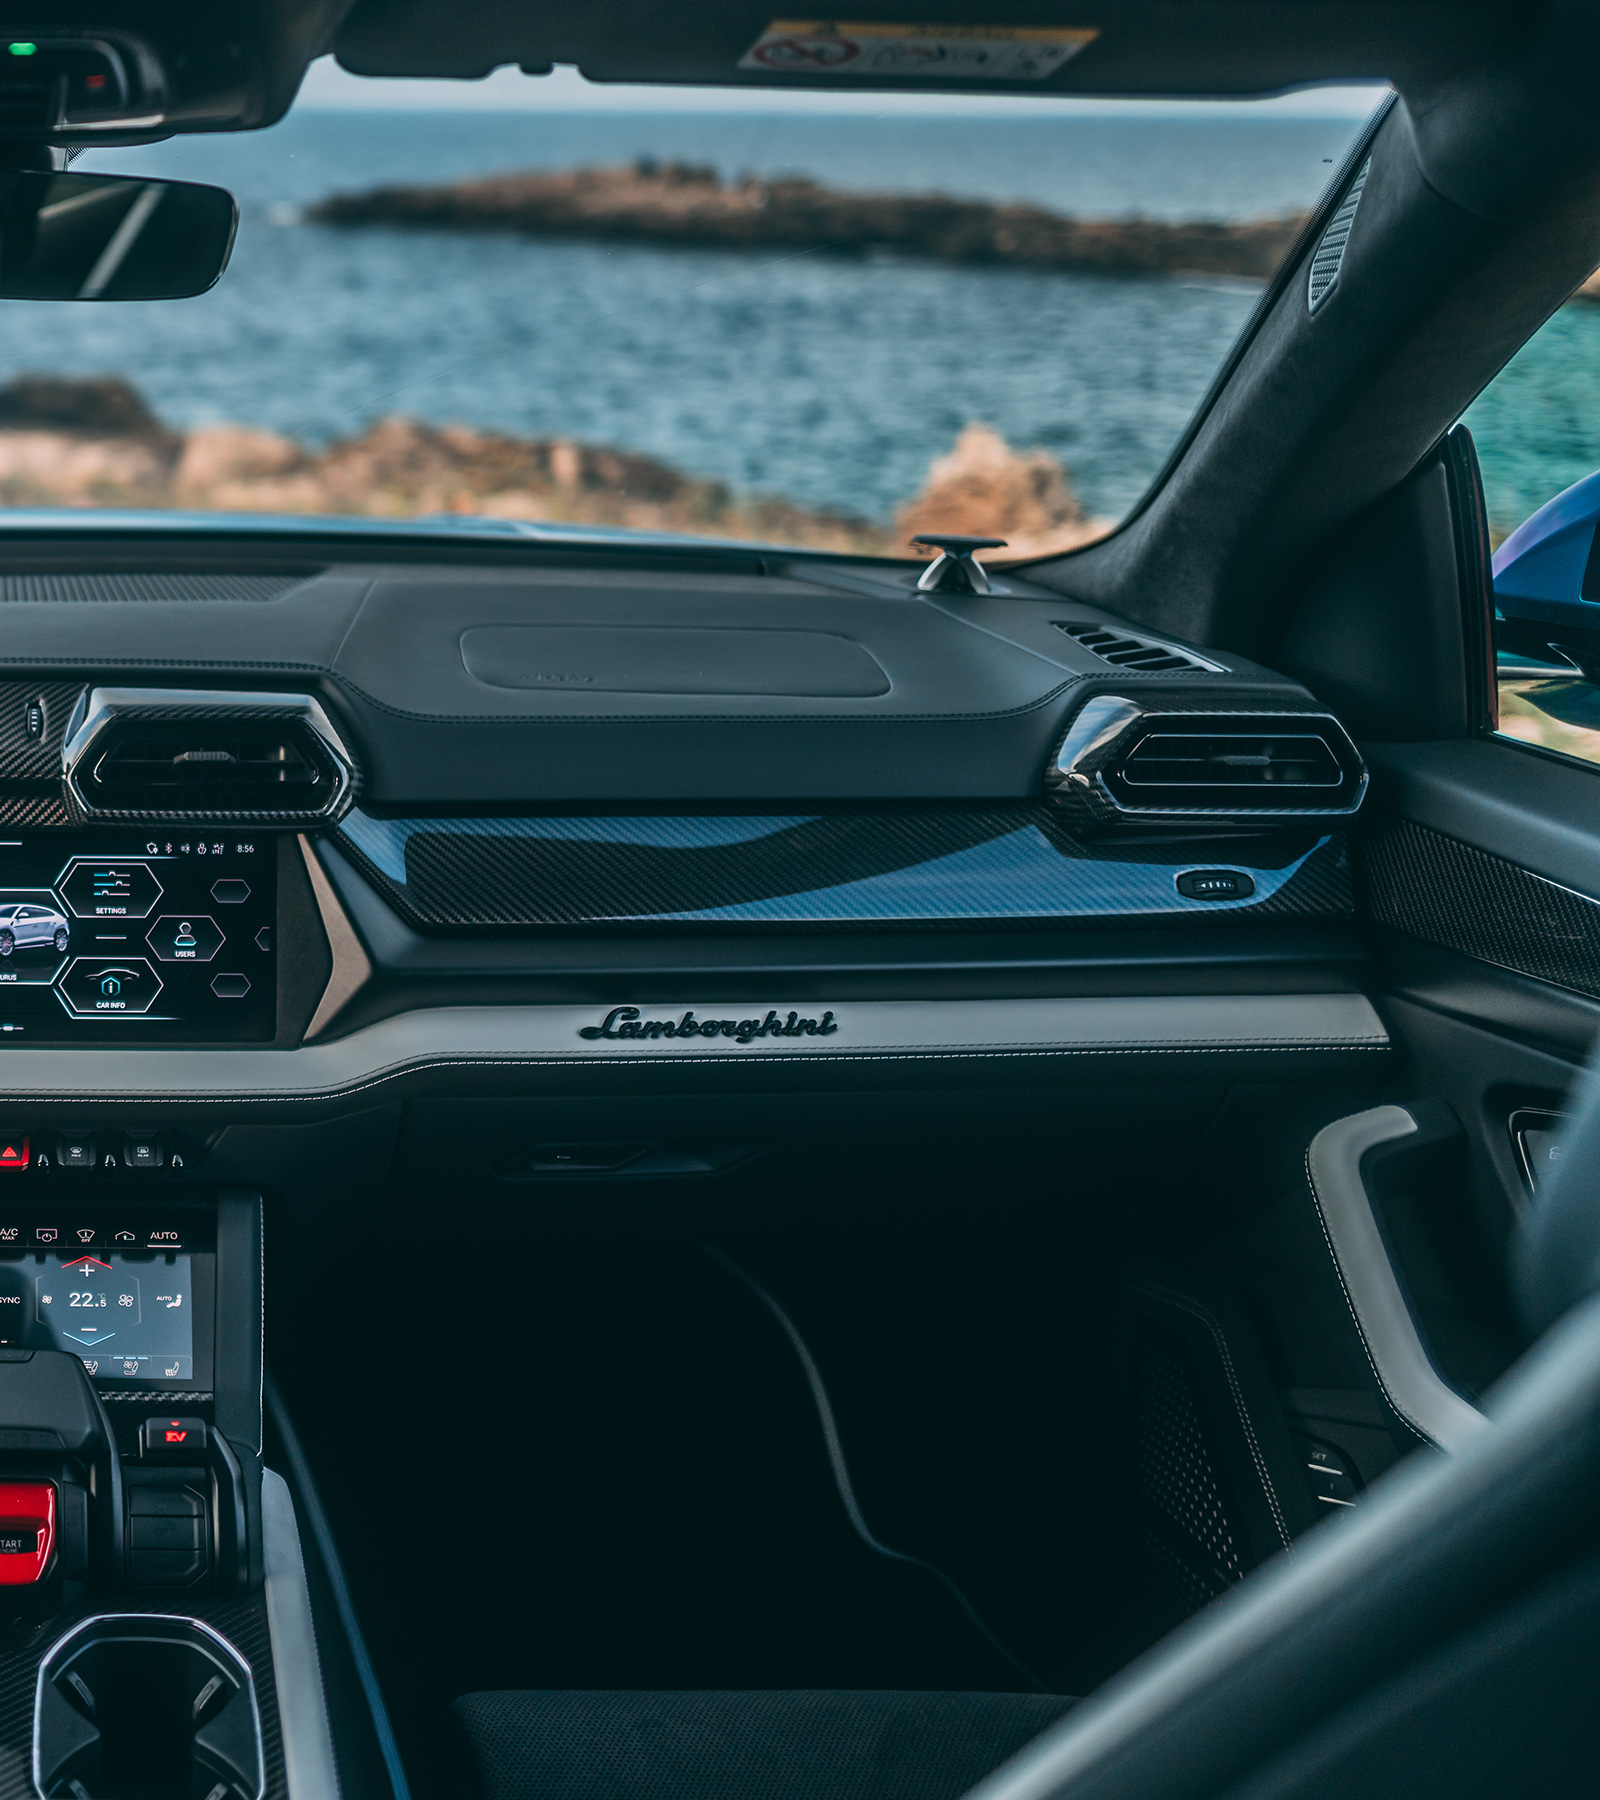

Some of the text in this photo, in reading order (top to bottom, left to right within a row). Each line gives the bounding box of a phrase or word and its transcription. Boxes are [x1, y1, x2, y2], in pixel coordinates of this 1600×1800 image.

[237, 844, 255, 853] 8:56
[95, 907, 127, 915] SETTINGS
[175, 950, 196, 958] USERS
[0, 973, 17, 982] URUS
[96, 1001, 126, 1009] CAR INFO
[579, 1006, 838, 1044] Lamborghini
[0, 1228, 19, 1237] A/C
[149, 1231, 179, 1240] AUTO
[165, 1430, 187, 1443] EV
